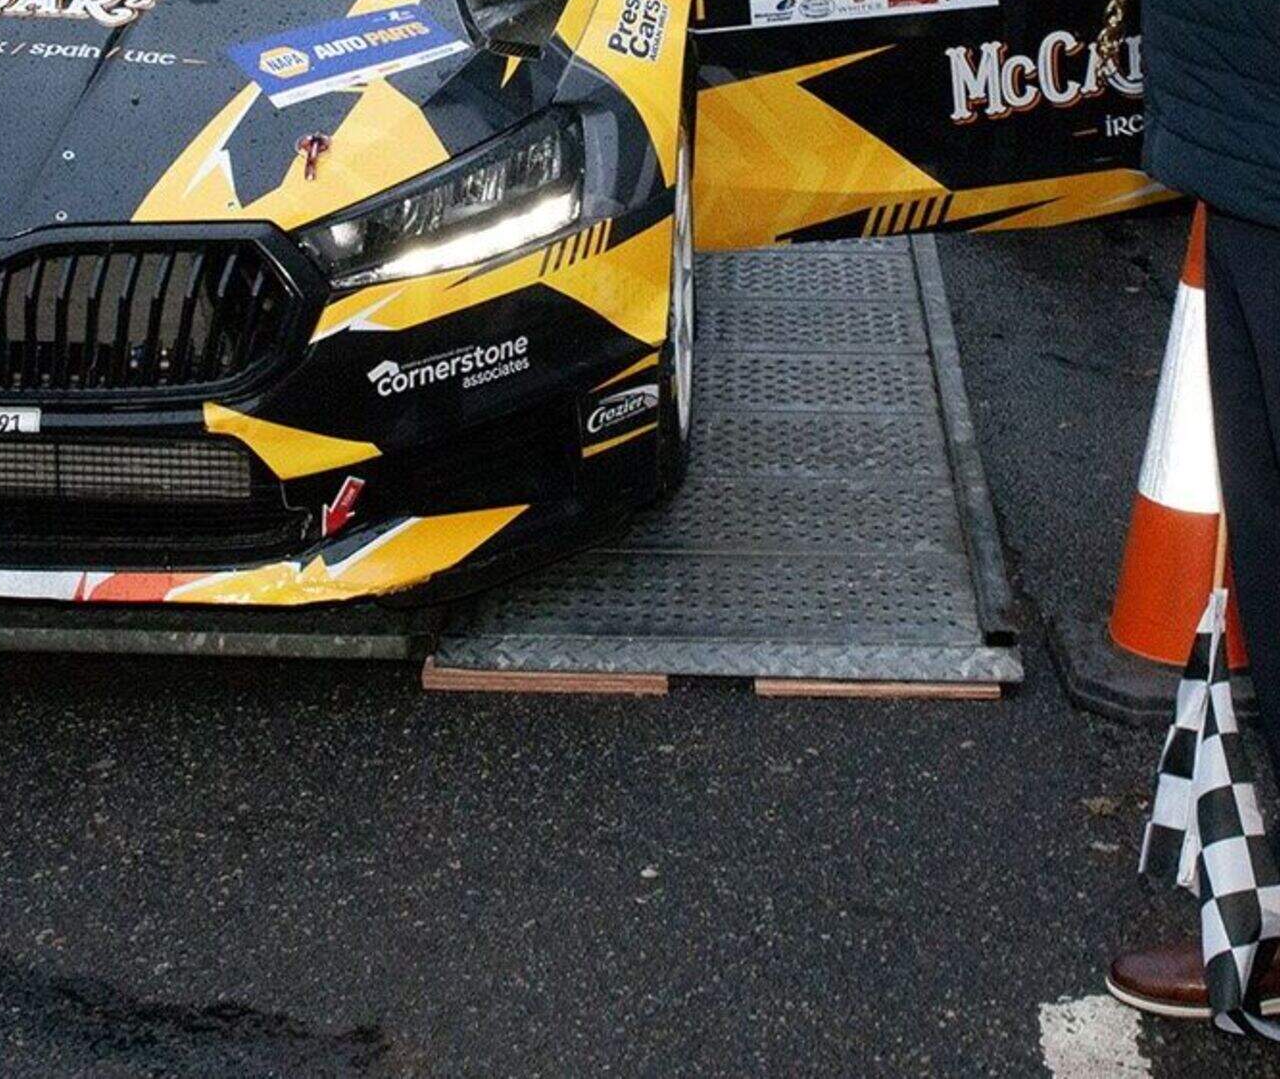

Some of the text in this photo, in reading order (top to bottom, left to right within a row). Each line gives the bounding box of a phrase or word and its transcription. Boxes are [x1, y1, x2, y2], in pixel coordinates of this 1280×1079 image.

[266, 21, 431, 72] NAPA AUTO PARTS
[377, 335, 529, 397] cornerstone
[462, 357, 530, 388] associates
[587, 392, 645, 434] Crozier
